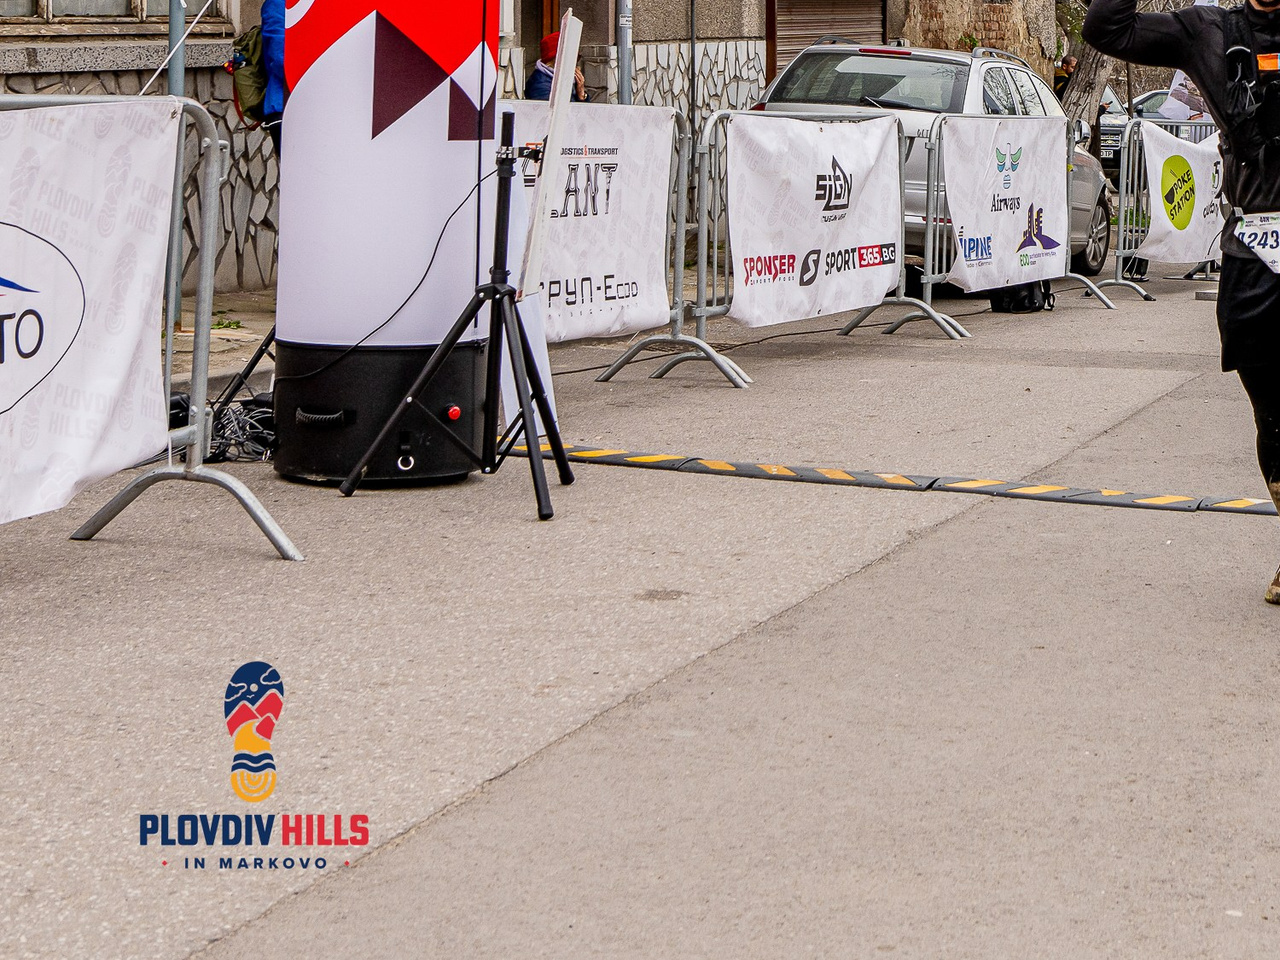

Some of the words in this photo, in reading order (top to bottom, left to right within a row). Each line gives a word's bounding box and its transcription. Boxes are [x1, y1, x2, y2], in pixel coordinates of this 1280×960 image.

[587, 147, 619, 156] TRANSPORT
[1172, 169, 1192, 195] POKE
[990, 193, 1021, 215] Airways
[1169, 184, 1195, 220] STATION
[743, 254, 796, 287] SPONSER
